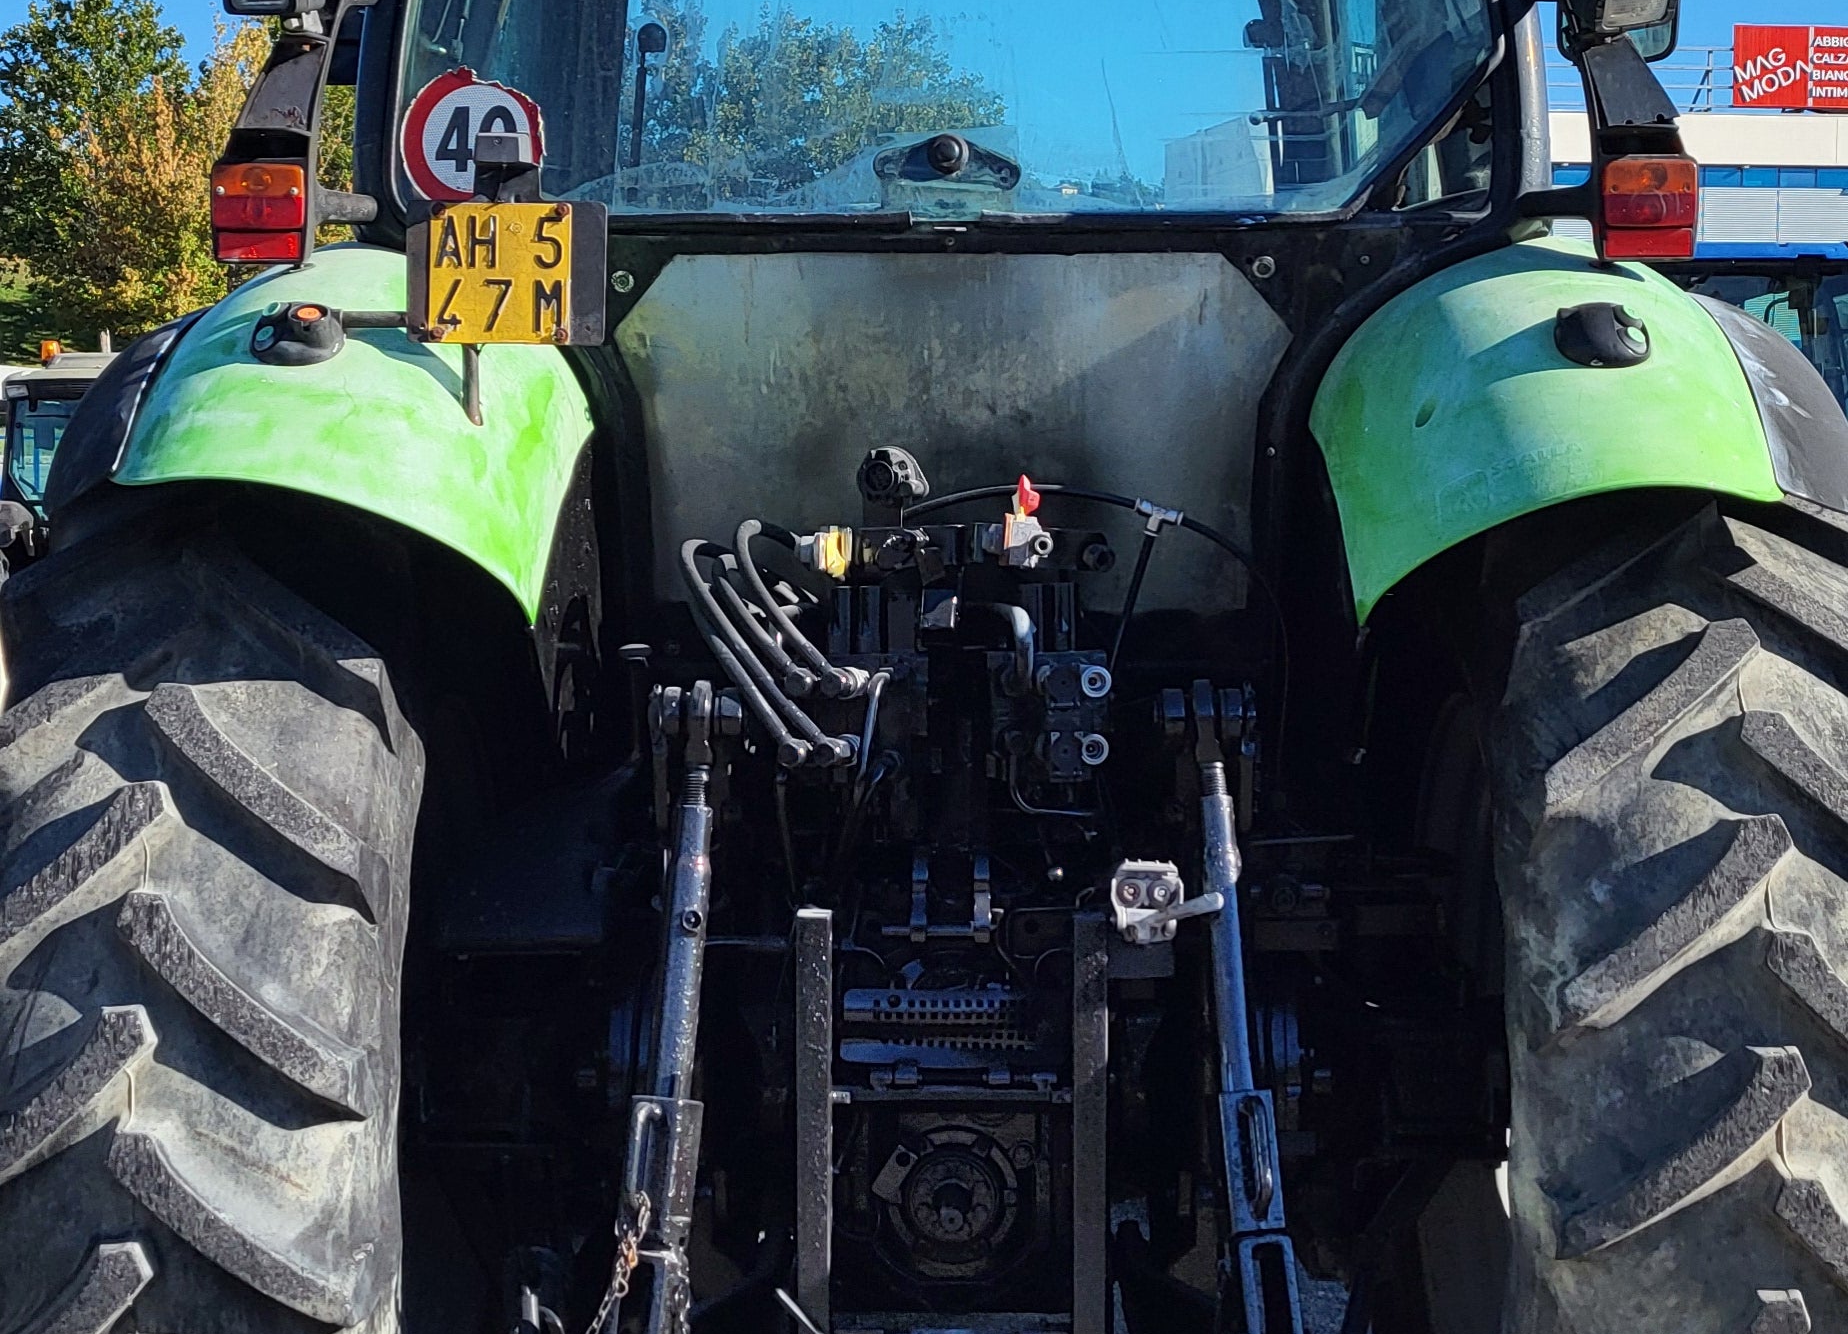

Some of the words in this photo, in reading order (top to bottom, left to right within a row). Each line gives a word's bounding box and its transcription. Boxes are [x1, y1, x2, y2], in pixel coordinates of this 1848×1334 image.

[1734, 47, 1786, 83] MAG
[1813, 53, 1848, 64] CALZ
[1740, 59, 1812, 103] MODA
[434, 215, 498, 269] AH
[531, 215, 565, 270] 5
